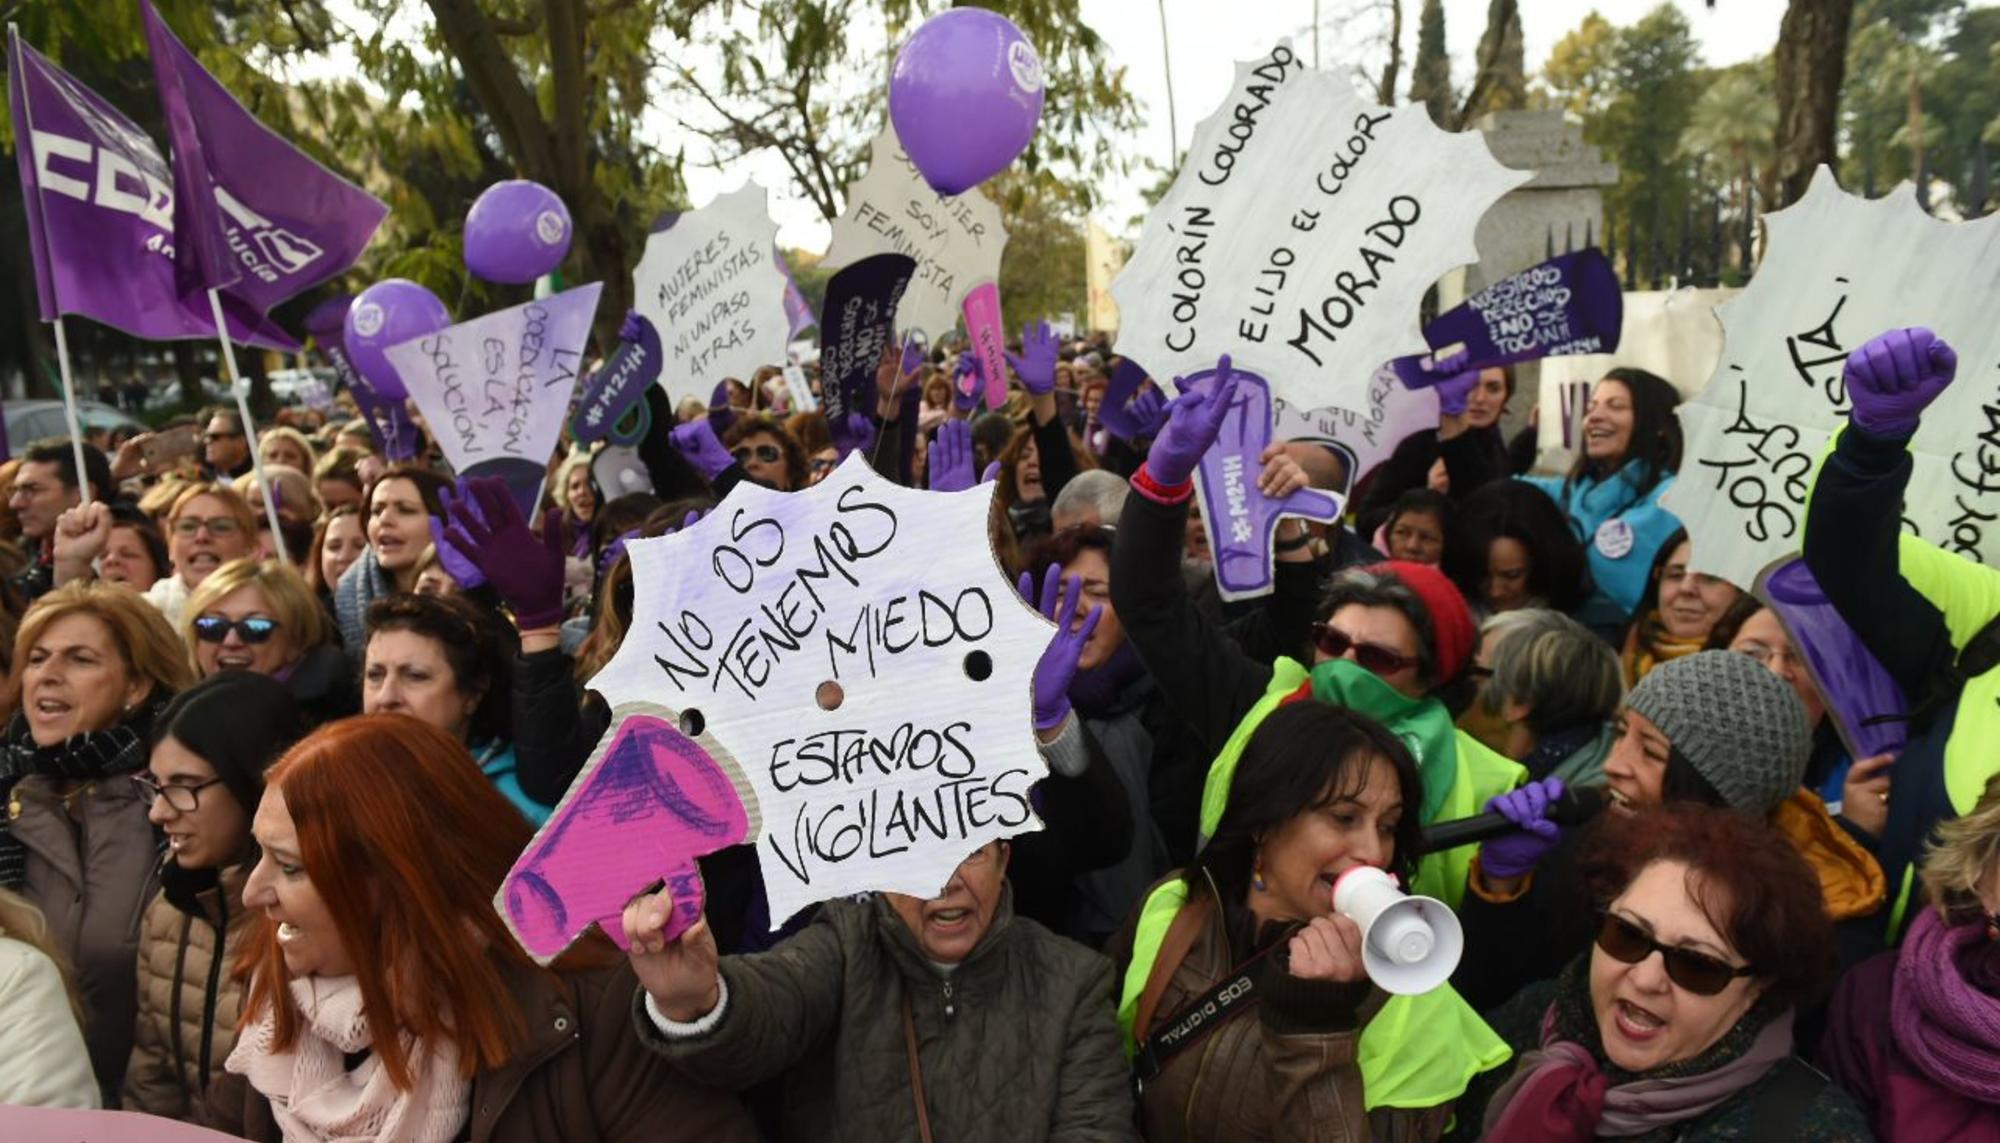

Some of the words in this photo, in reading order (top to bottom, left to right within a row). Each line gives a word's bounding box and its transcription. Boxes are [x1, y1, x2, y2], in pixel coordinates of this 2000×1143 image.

[906, 199, 947, 240] SOY
[937, 195, 985, 246] UJER
[1165, 206, 1216, 353] COLORÍN
[1198, 45, 1303, 186] COLORADO,
[1239, 246, 1295, 343] ELIJO
[1291, 209, 1320, 232] EL
[1317, 112, 1393, 195] COLOR
[658, 230, 729, 309] MUJERES
[853, 201, 954, 304] FEMINISTA
[1288, 194, 1421, 367] MORADO
[1468, 265, 1562, 311] NUESTROS
[1482, 287, 1571, 324] DERECHOS
[1536, 305, 1568, 327] SE
[483, 337, 506, 376] ES
[502, 305, 549, 454] COEDUCACIÓN
[544, 347, 581, 389] LA
[674, 333, 691, 360] NI
[690, 318, 756, 377] ATRÁS
[482, 379, 507, 417] LA
[585, 342, 646, 428] #M24H
[1221, 454, 1253, 544] #M24H
[1698, 457, 1797, 542] SOY
[653, 608, 713, 692] NO
[712, 507, 785, 593] OS
[712, 484, 898, 700] TENEMOS
[826, 585, 994, 680] MIEDO
[769, 721, 977, 793] ESTAMOS
[769, 769, 1032, 885] VIGILANTES
[1160, 1001, 1217, 1046] DIGITAL
[1218, 976, 1253, 1007] EOS
